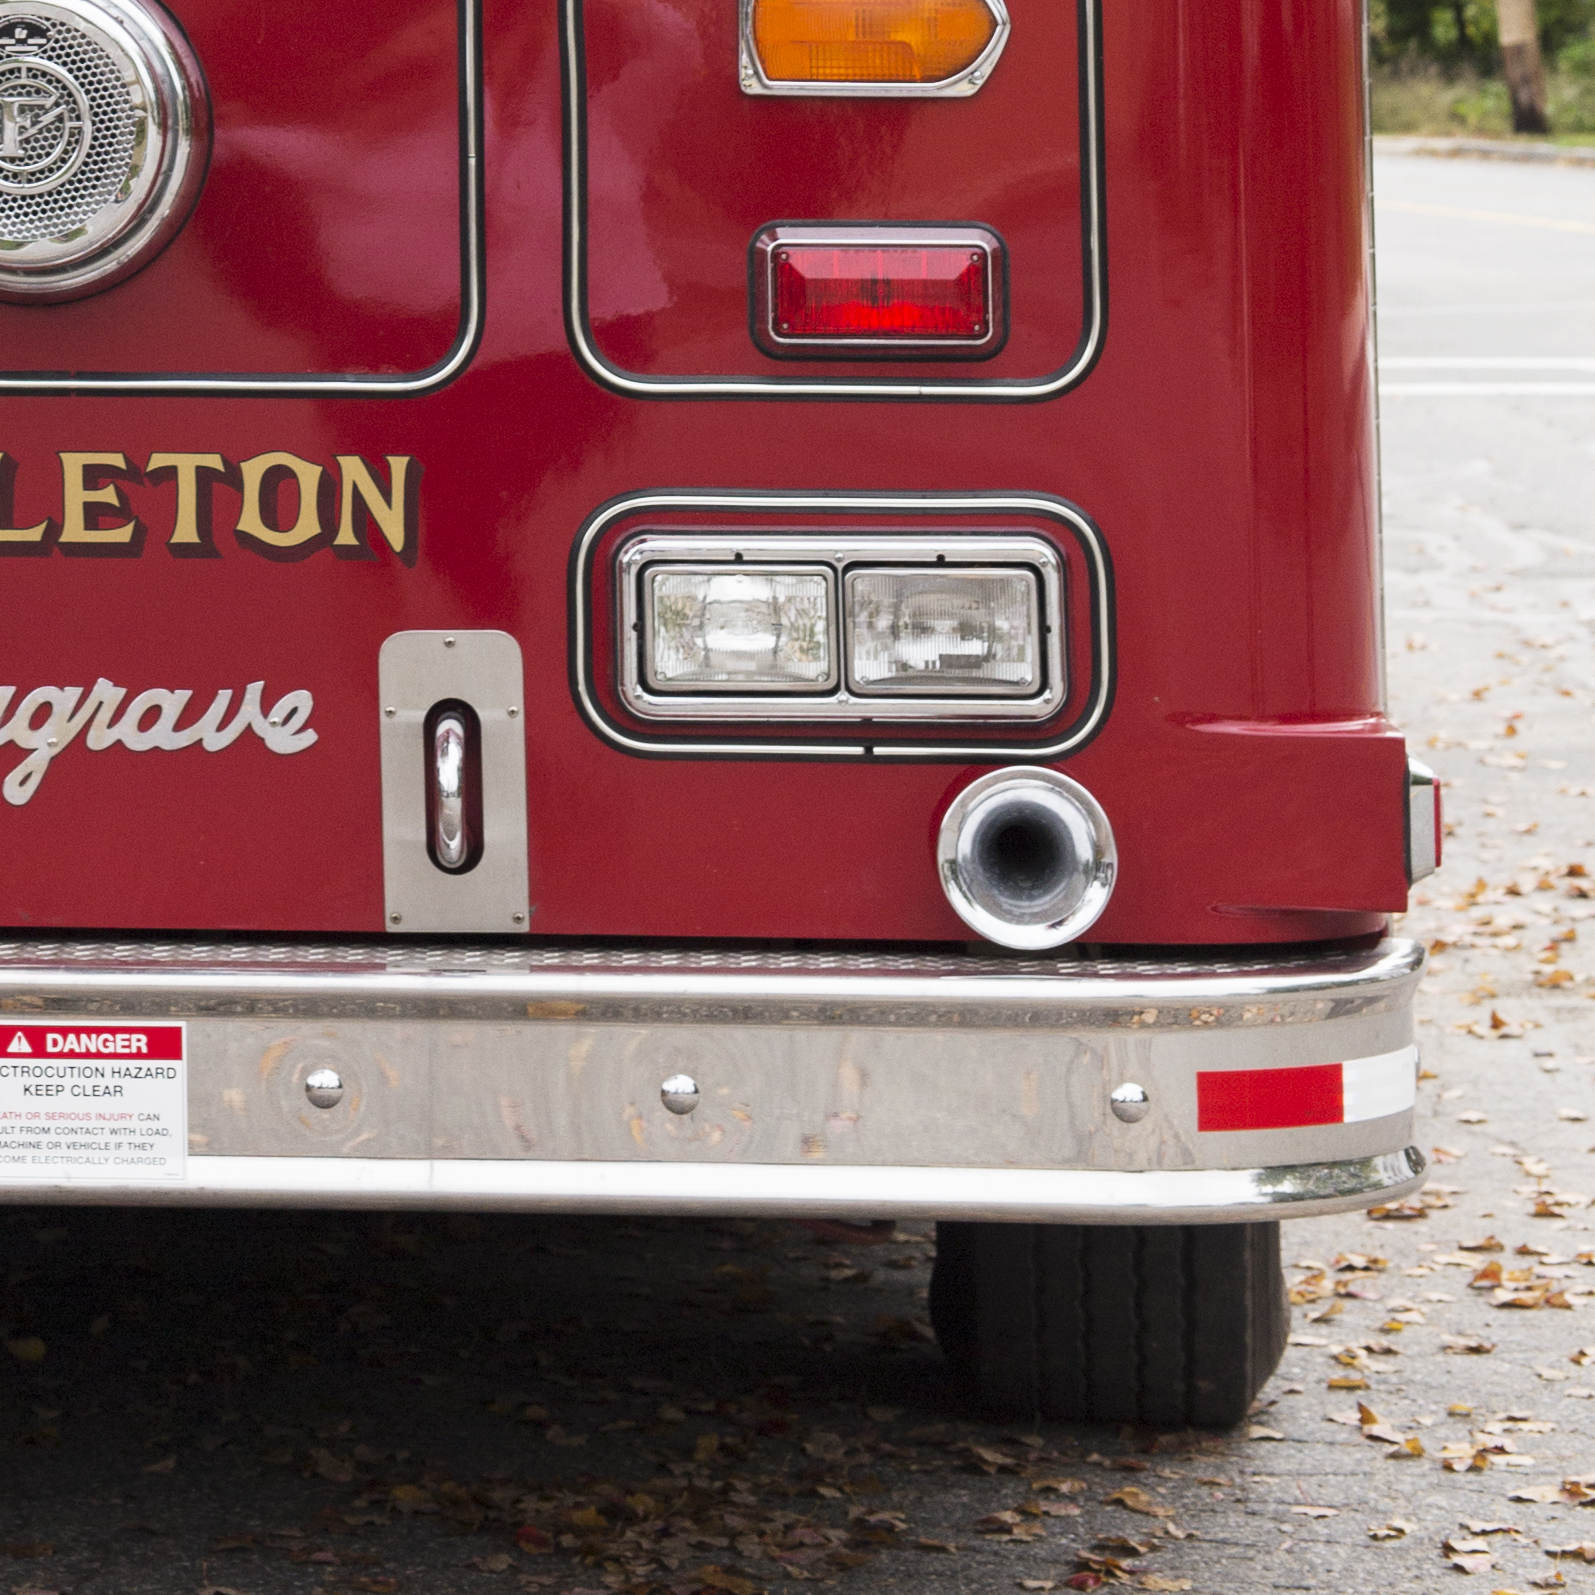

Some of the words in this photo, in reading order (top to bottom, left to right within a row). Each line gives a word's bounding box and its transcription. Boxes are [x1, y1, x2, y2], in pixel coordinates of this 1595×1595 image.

[45, 1033, 148, 1054] DANGER
[111, 1066, 177, 1080] HAZARD
[23, 1083, 65, 1097] KEEP
[70, 1084, 124, 1097] CLEAR
[25, 1111, 41, 1121] OR
[44, 1111, 92, 1121] SERIOUS
[95, 1112, 135, 1122] INJURY
[137, 1112, 160, 1122] CAN
[19, 1126, 51, 1135] FROM
[54, 1126, 105, 1136] CONTACT
[109, 1127, 136, 1137] WITH
[139, 1127, 172, 1138] LOAD,
[46, 1140, 62, 1150] OR
[65, 1141, 111, 1151] VEHICLE
[114, 1141, 124, 1151] IF
[127, 1142, 155, 1151] THEY
[31, 1155, 110, 1165] ELECTRICALLY
[113, 1156, 167, 1166] CHARGED
